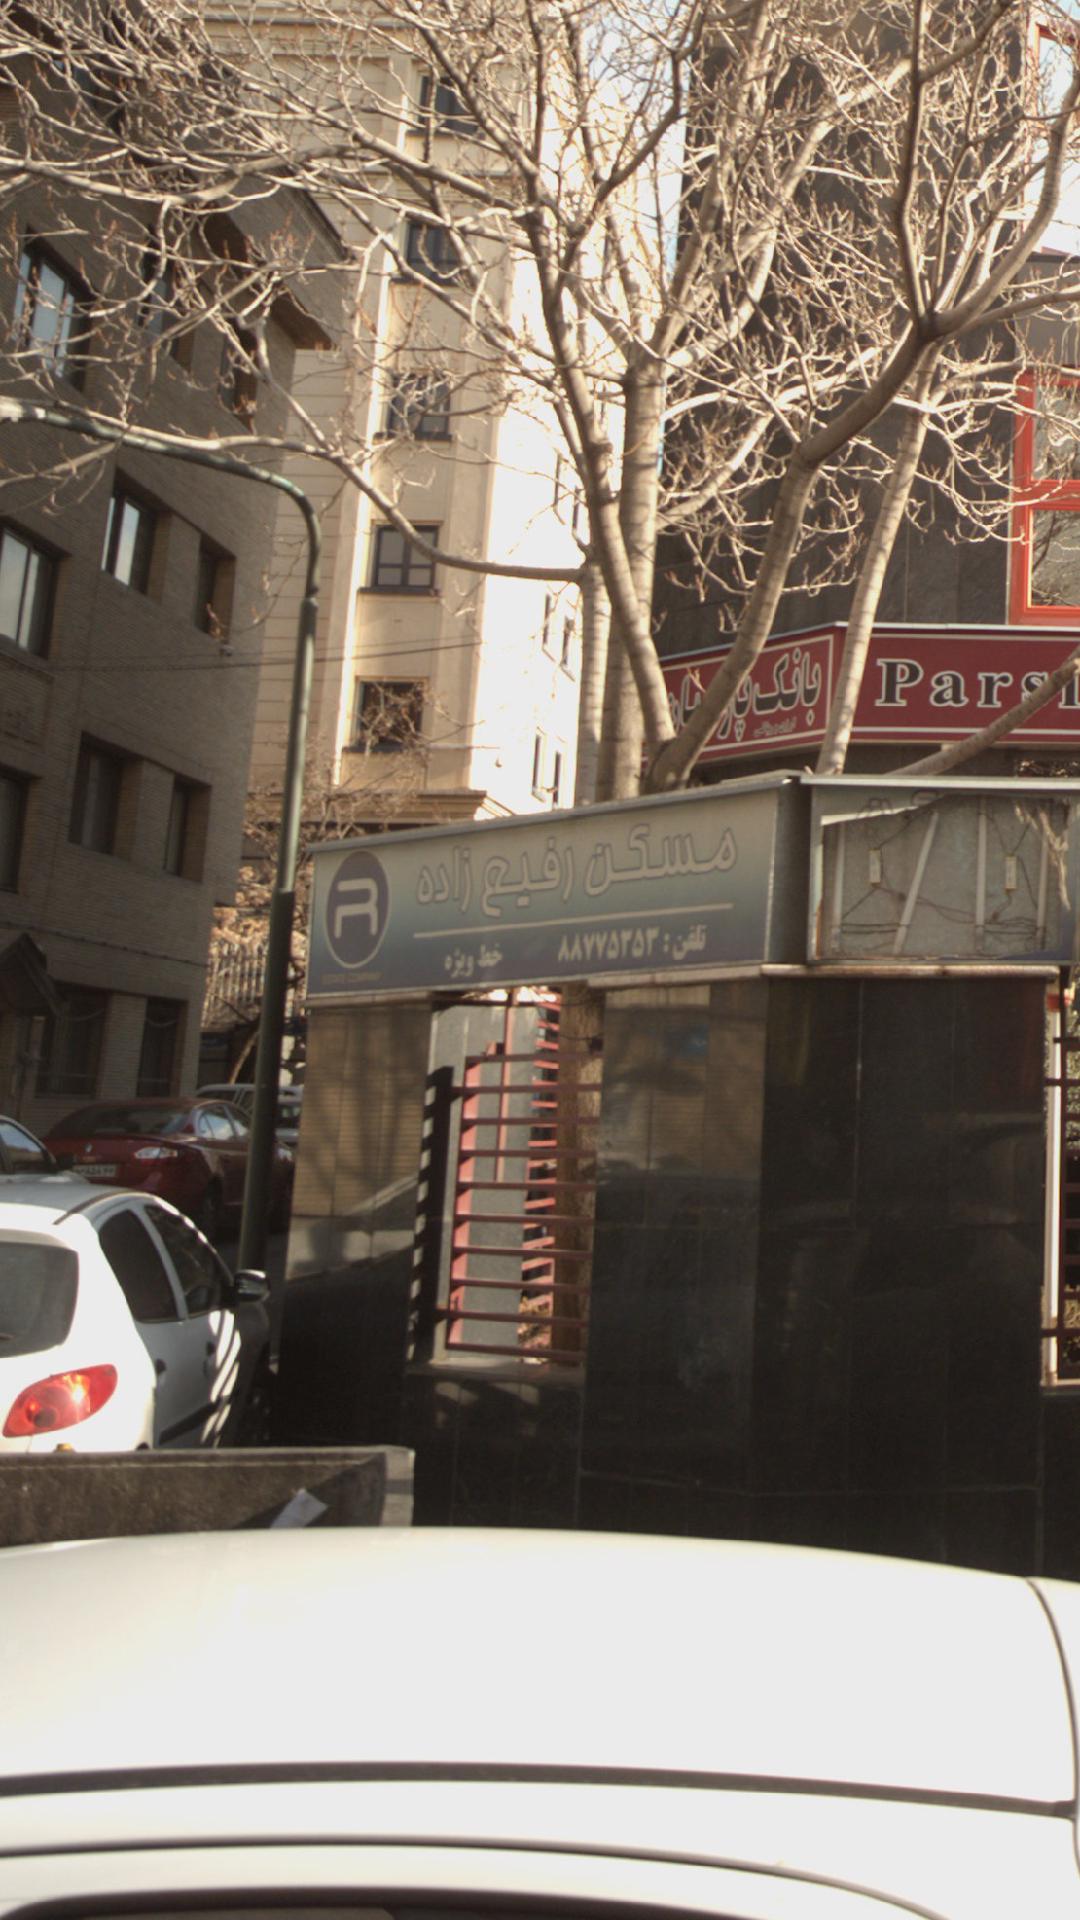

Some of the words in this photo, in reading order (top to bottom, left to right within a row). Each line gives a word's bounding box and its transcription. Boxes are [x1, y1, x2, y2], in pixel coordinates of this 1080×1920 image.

[752, 648, 821, 725] بانک
[583, 823, 738, 896] مسکن
[444, 947, 474, 978] ویژه
[478, 943, 503, 967] خط
